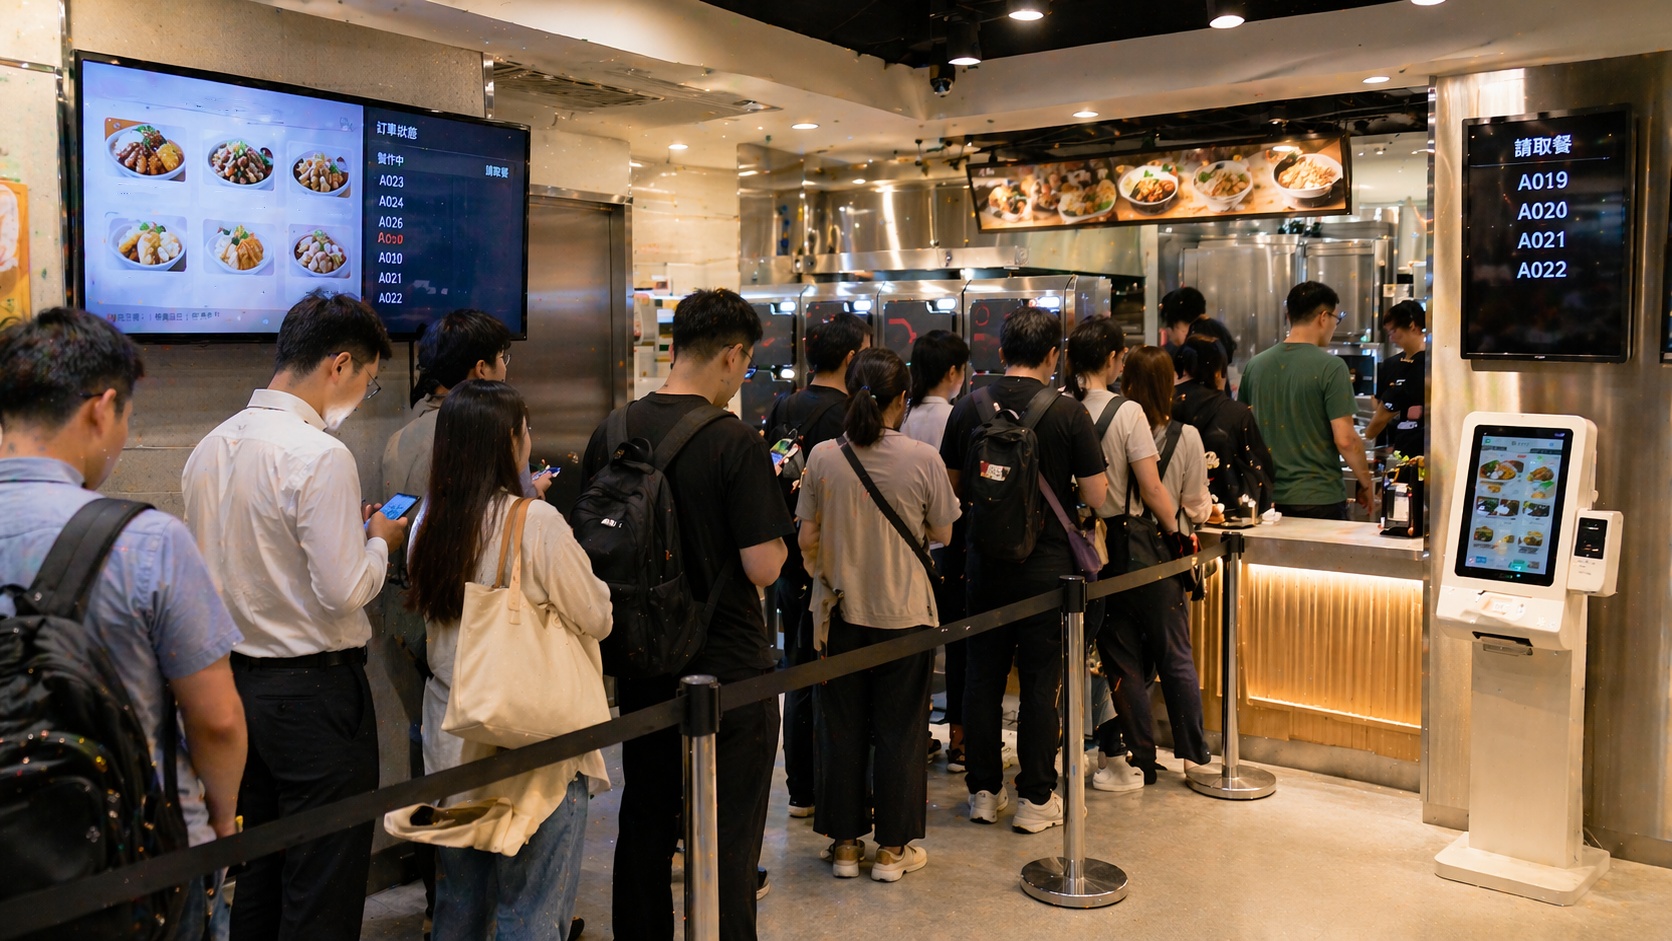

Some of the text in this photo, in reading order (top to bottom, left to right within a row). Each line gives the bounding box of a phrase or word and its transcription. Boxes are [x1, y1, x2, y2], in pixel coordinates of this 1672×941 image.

[1514, 134, 1573, 158] 請取餐
[379, 174, 404, 188] A023
[1517, 171, 1568, 191] A019
[378, 195, 404, 209] A024
[1517, 201, 1567, 221] A020
[378, 216, 404, 229] A026
[1517, 230, 1565, 249] A021
[378, 251, 403, 265] A010
[1516, 260, 1567, 279] A022
[378, 272, 402, 284] A021
[378, 292, 403, 304] A022
